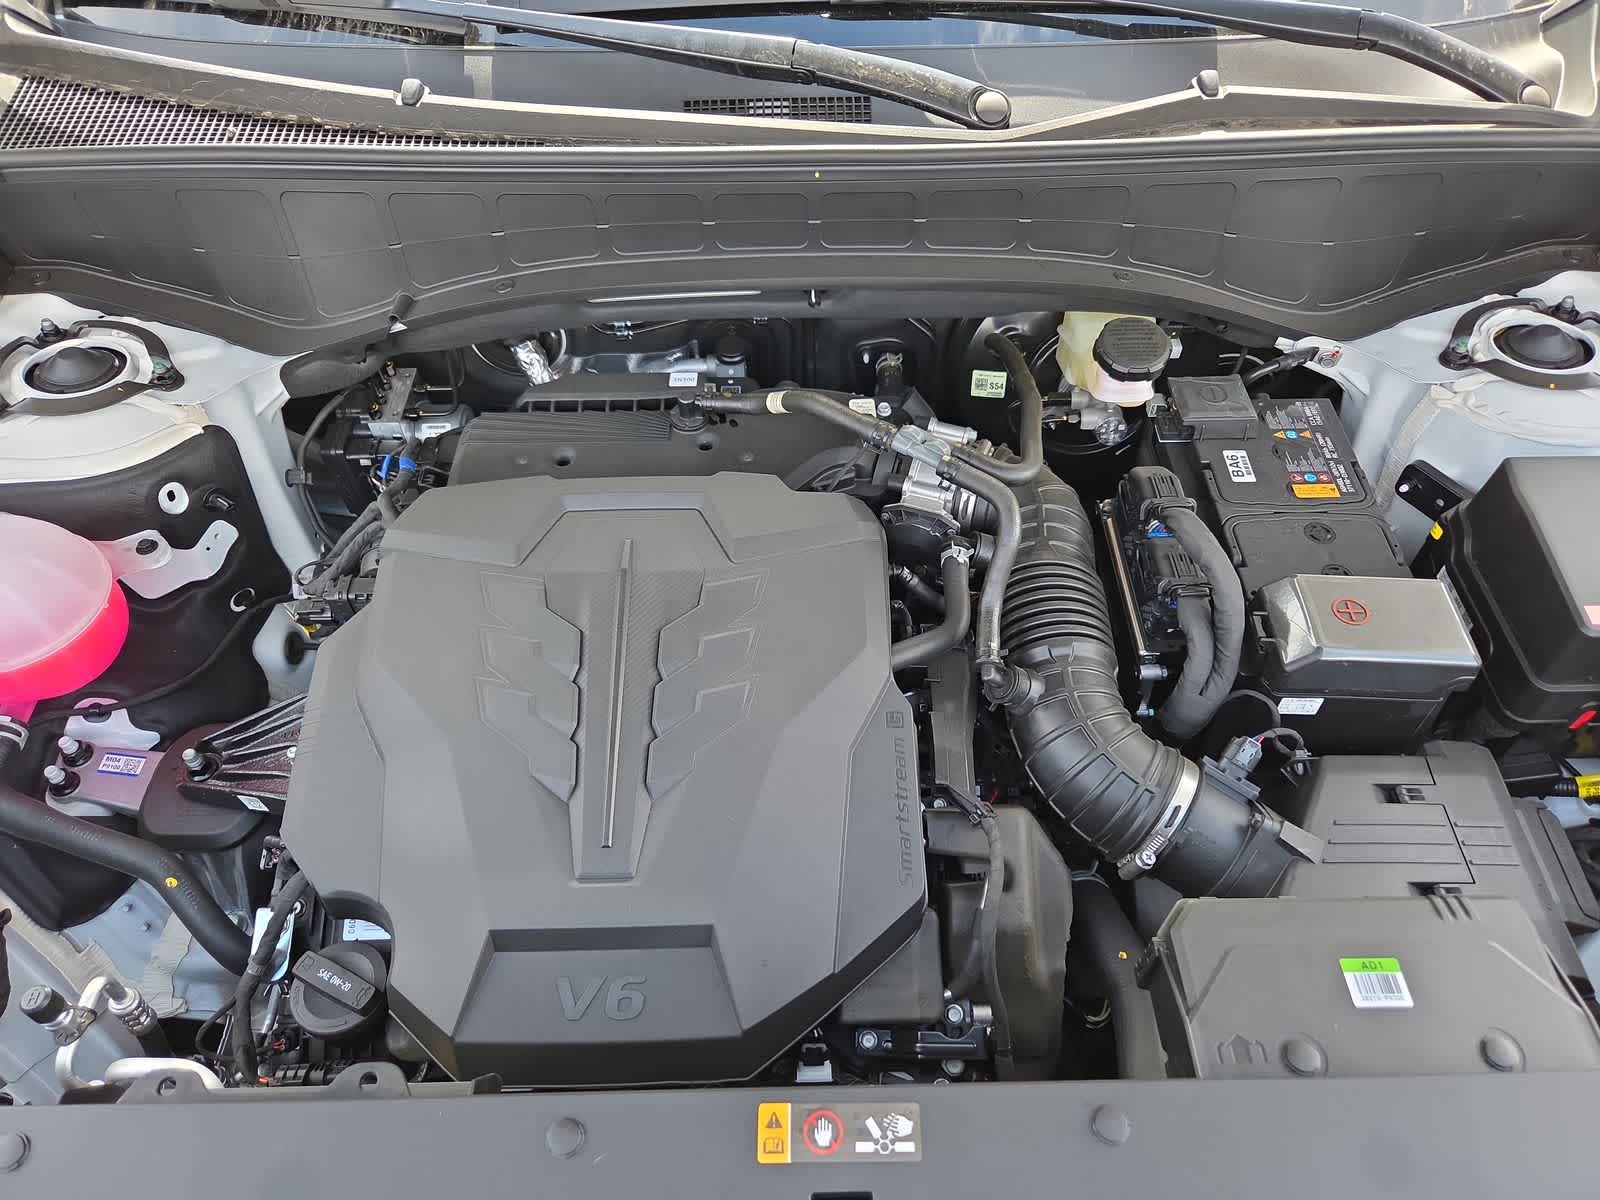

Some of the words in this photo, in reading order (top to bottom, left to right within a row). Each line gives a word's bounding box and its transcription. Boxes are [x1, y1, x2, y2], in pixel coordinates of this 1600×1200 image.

[989, 382, 1004, 391] S54
[1226, 454, 1245, 478] BA6
[1361, 960, 1385, 970] AD1
[317, 968, 333, 981] SAE
[552, 975, 648, 1021] V6
